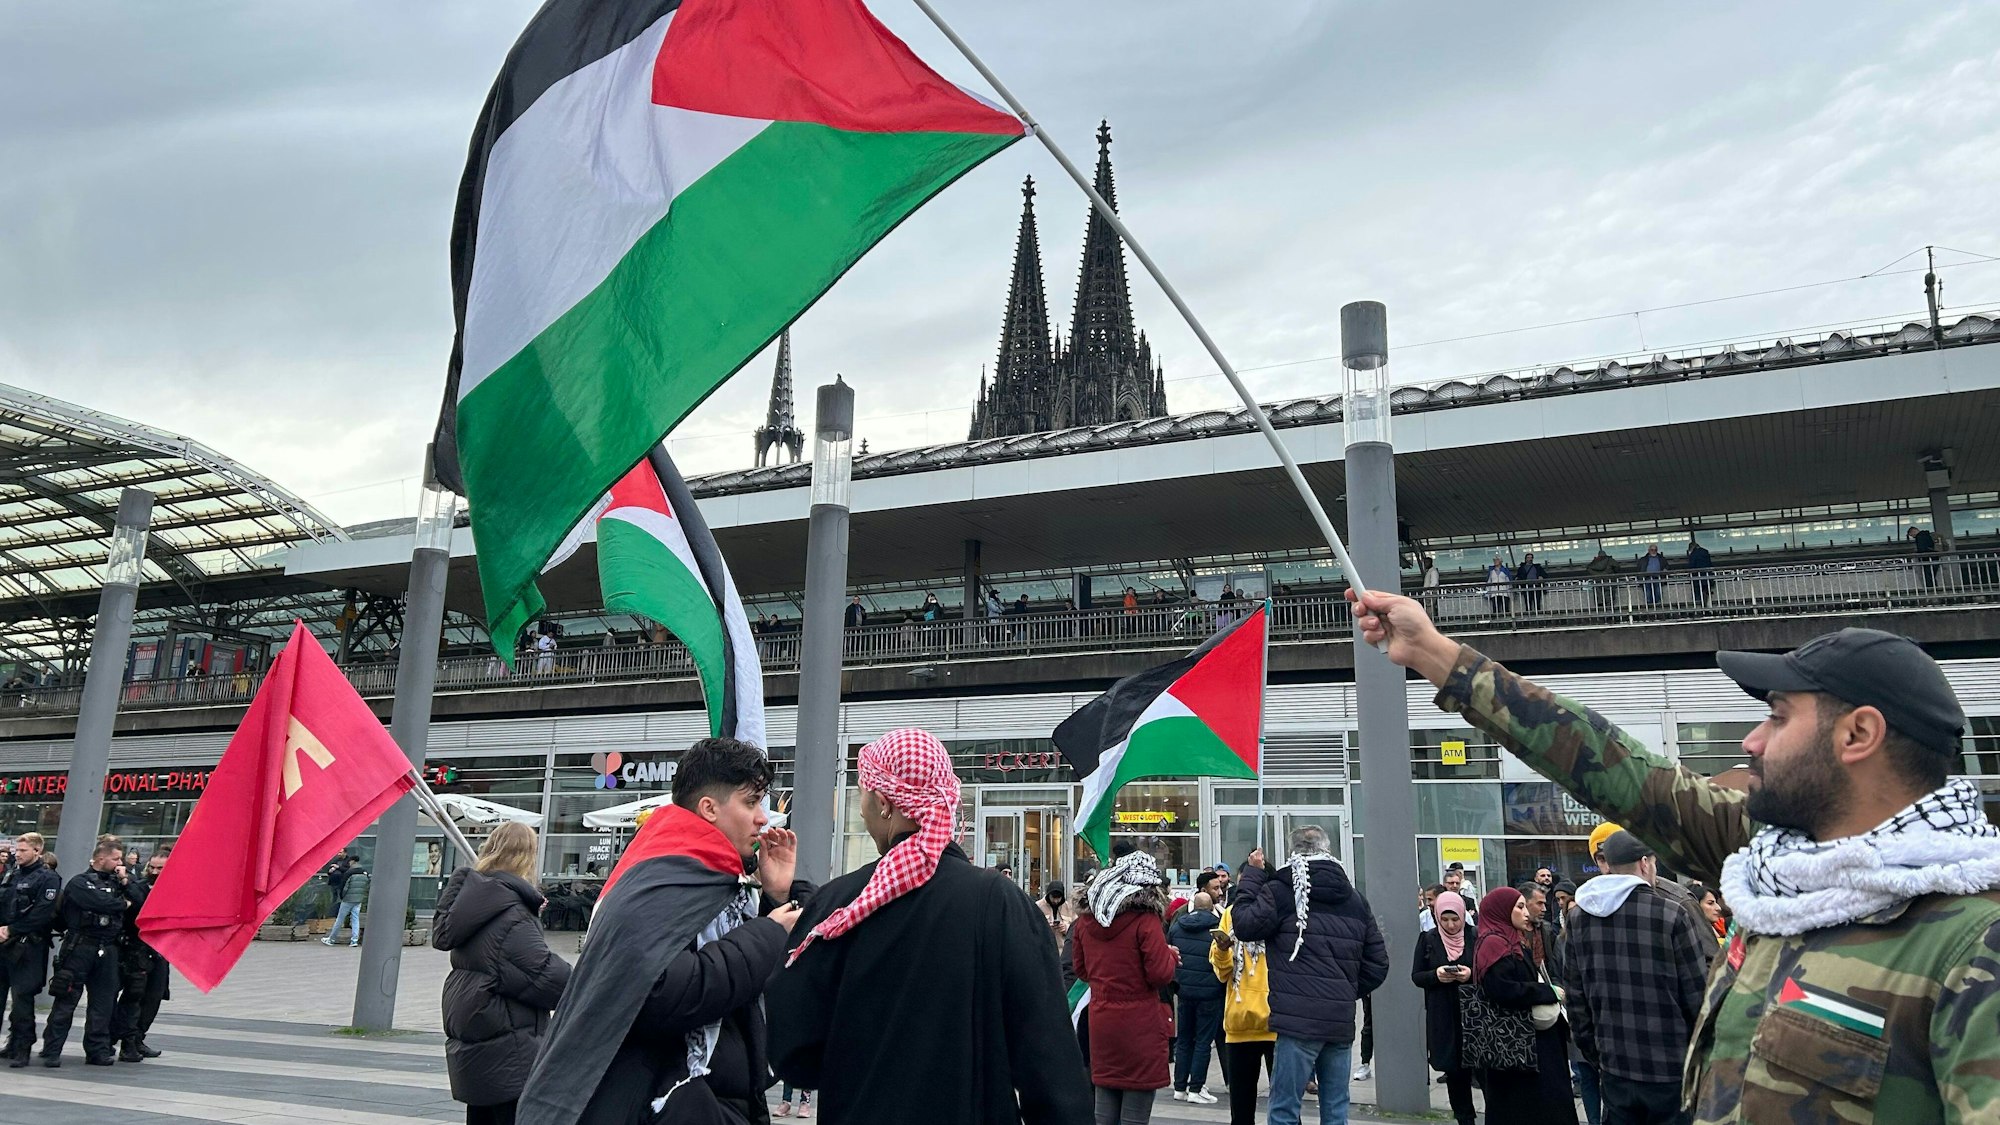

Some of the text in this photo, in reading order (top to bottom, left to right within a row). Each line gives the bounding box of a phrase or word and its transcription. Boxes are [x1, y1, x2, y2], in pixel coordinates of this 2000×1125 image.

[1443, 749, 1463, 757] ATM
[984, 751, 1063, 772] ECKERT
[622, 761, 679, 783] CAMP
[17, 770, 213, 795] INTERIONAL PHA
[1564, 812, 1606, 826] WER
[589, 845, 610, 853] SNACK
[596, 853, 610, 861] COF
